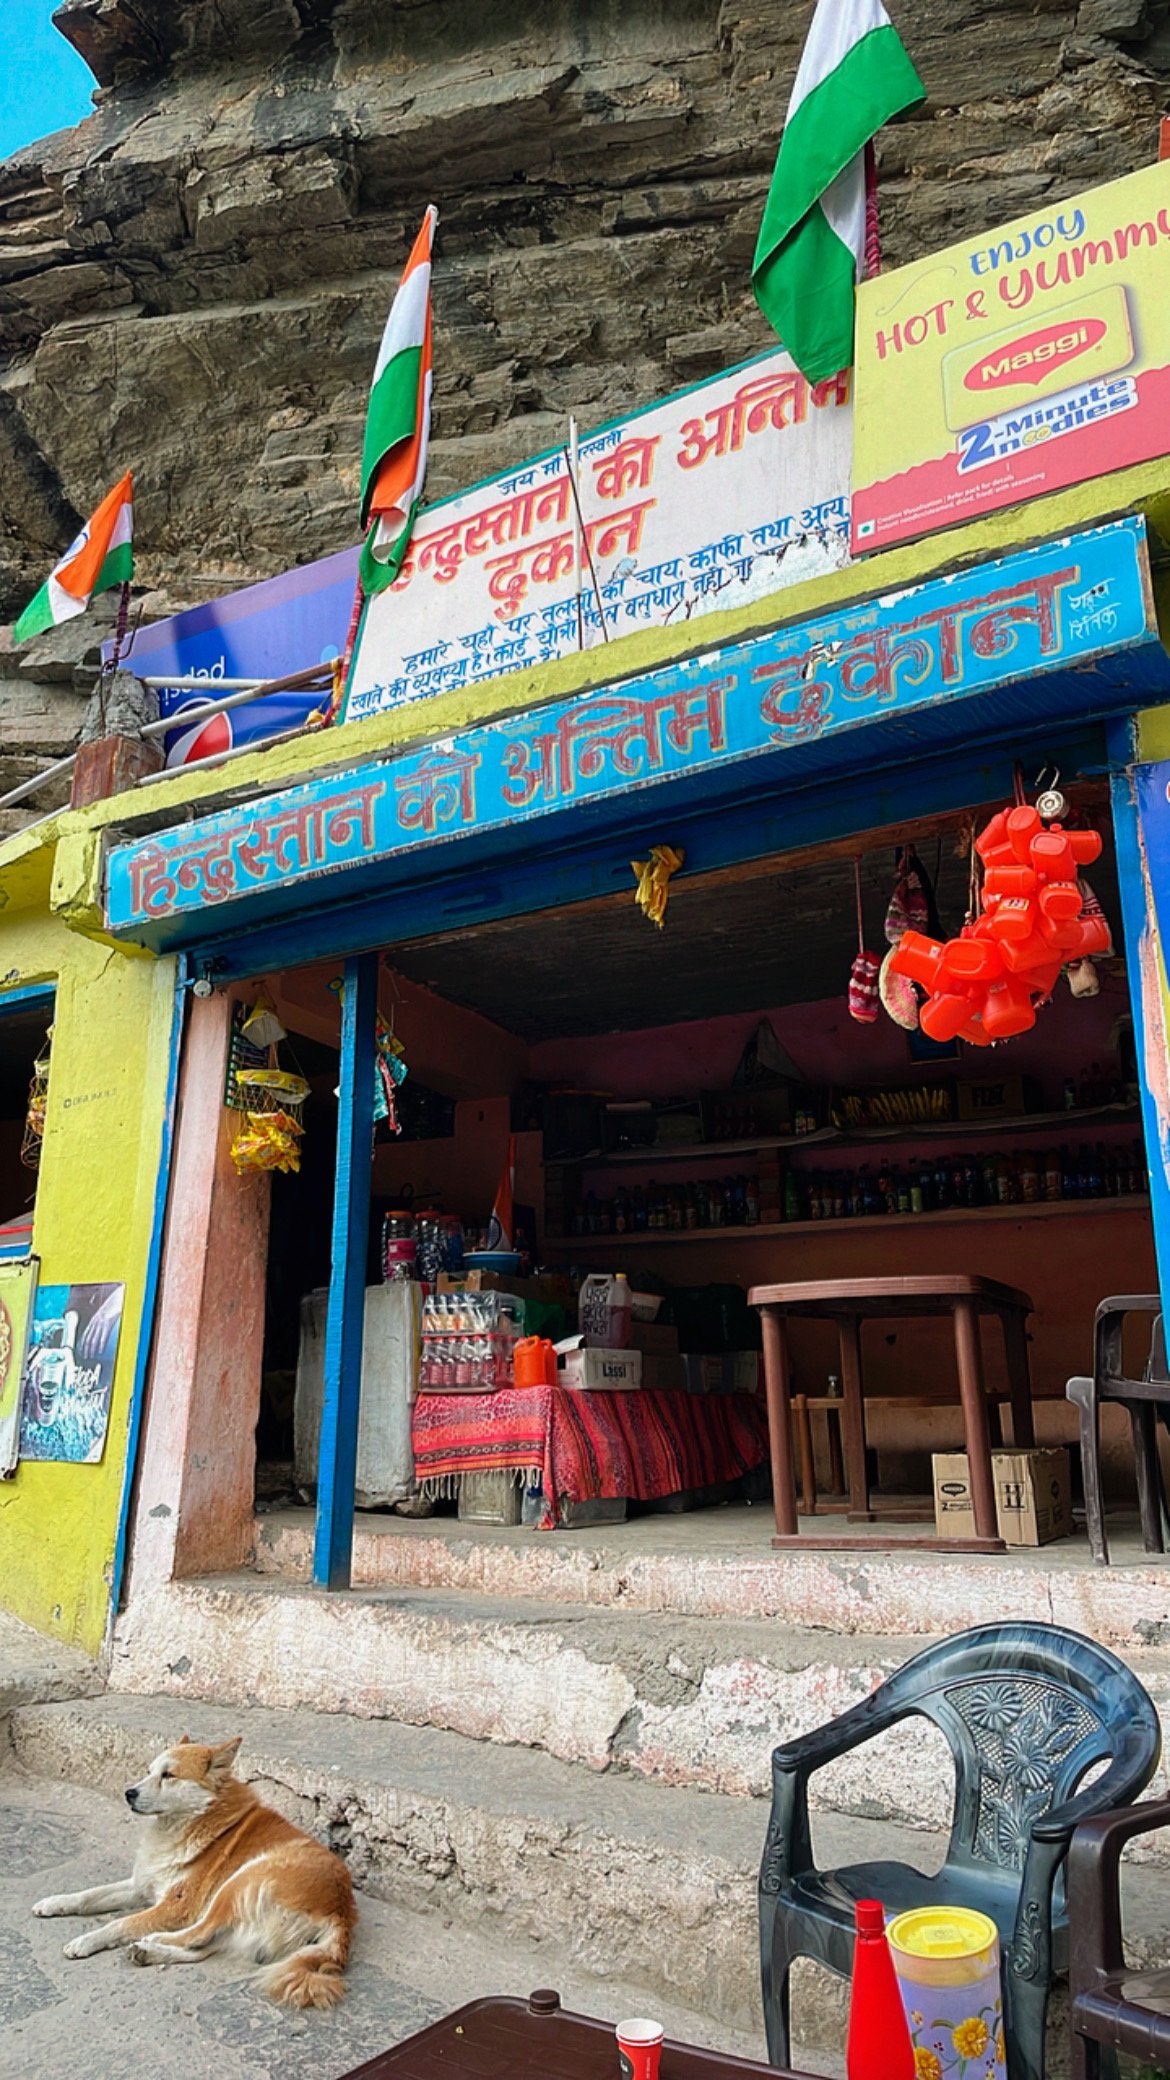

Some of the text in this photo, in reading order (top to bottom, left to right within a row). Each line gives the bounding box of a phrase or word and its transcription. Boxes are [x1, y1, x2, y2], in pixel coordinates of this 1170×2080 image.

[876, 300, 955, 360] HOT
[965, 289, 989, 321] &
[981, 326, 1089, 383] Maggi
[592, 435, 664, 499] की
[748, 515, 796, 545] तथा
[127, 780, 387, 919] हिन्दुस्तान
[395, 749, 482, 832] की
[501, 675, 738, 808] अन्तिम
